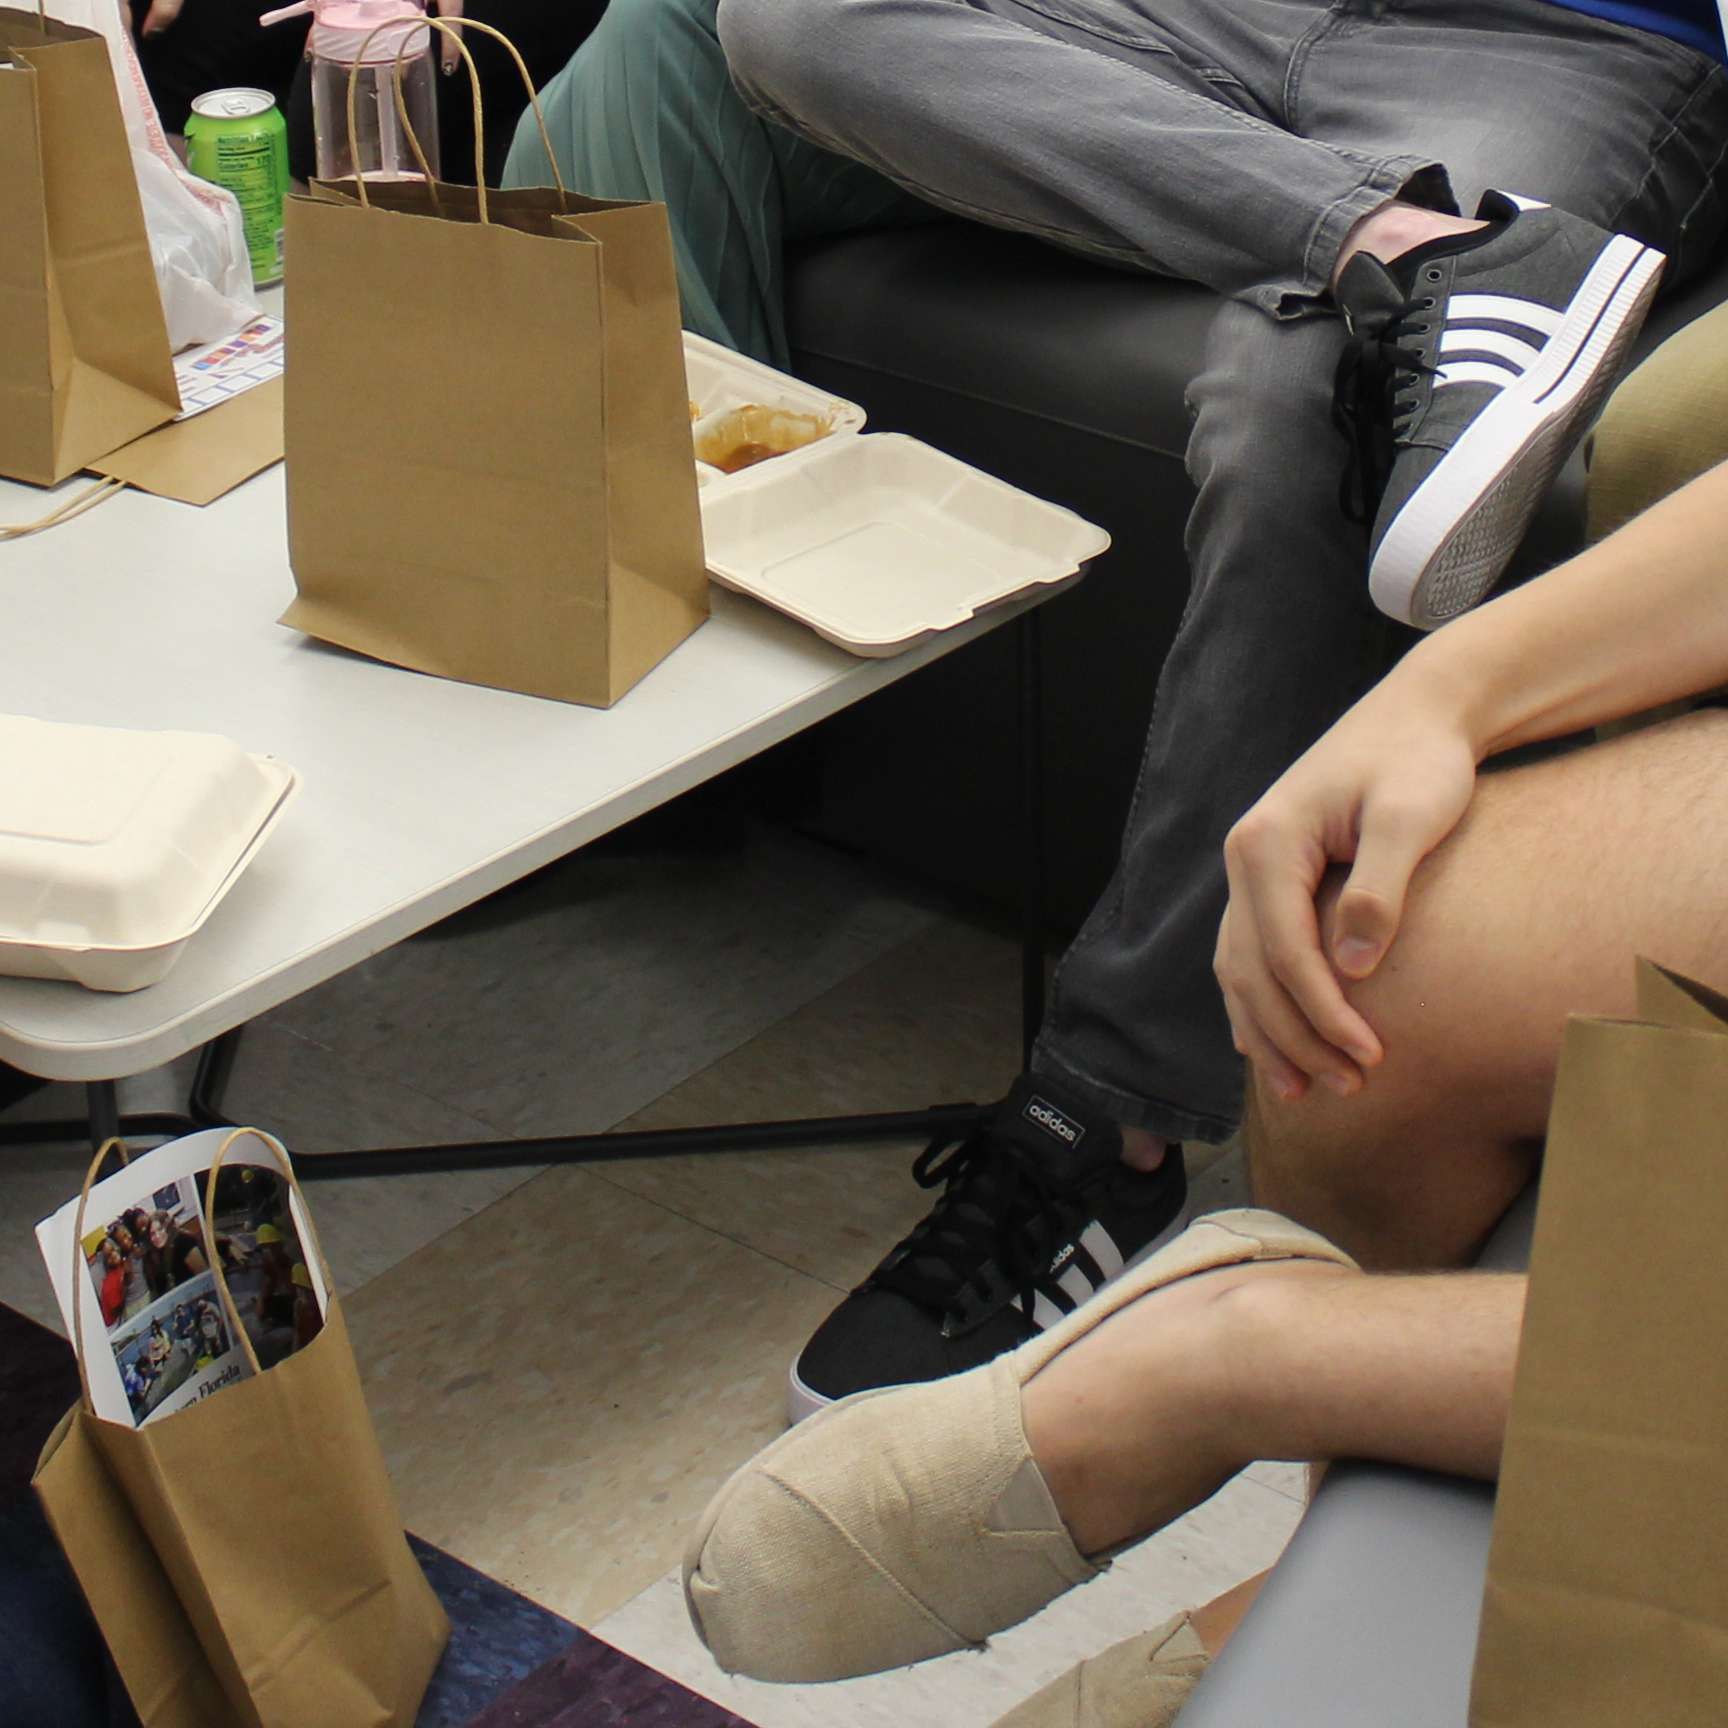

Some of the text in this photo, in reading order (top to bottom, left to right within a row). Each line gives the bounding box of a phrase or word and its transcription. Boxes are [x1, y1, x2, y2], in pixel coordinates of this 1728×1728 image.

[1029, 1103, 1076, 1142] adidas
[1048, 1243, 1075, 1273] idas
[198, 1364, 241, 1399] Florida
